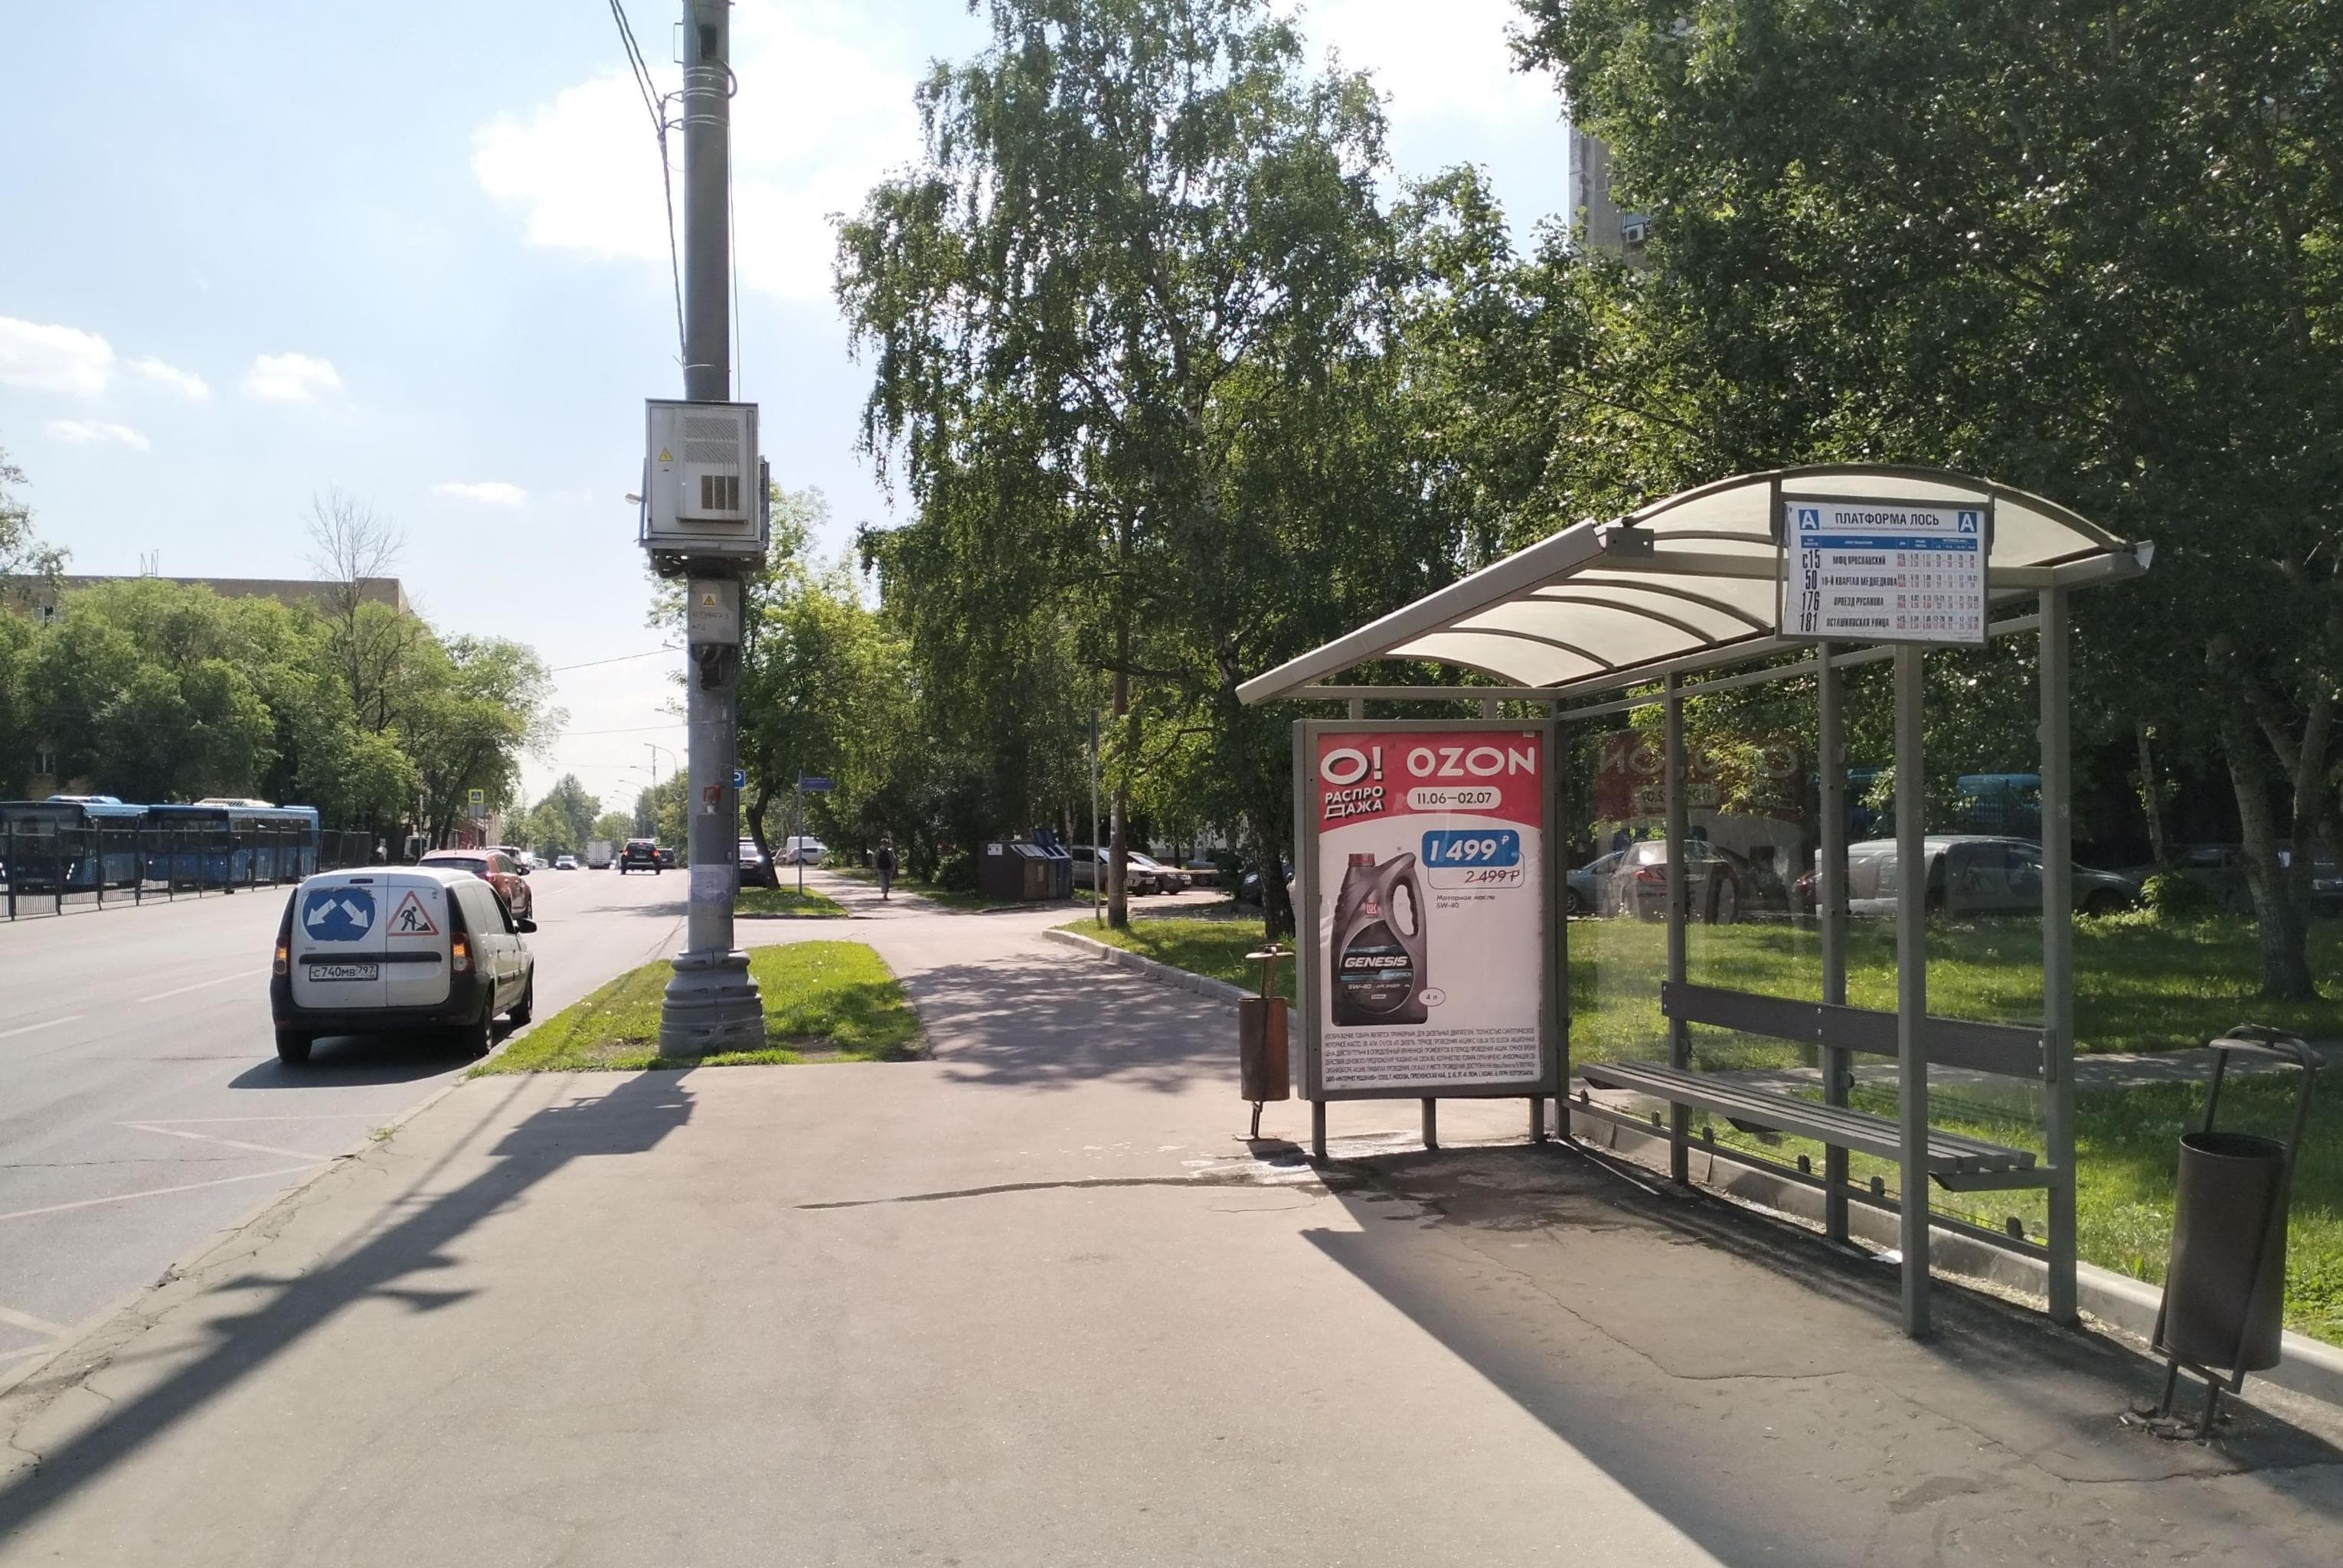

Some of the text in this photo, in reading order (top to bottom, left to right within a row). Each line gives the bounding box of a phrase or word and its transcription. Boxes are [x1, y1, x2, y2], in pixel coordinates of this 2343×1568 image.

[1801, 511, 1817, 529] А
[1835, 512, 1939, 526] ПЛАТФОРМА ЛОСЬ
[1959, 513, 1975, 532] А
[1848, 555, 1886, 565] ЯРОСЛАВСКИЙ
[1805, 570, 1818, 590] 50
[1835, 577, 1859, 586] КВАРТАЛ
[1860, 577, 1897, 586] МЕДВЕДКОВА
[1802, 591, 1820, 611] 176
[1833, 596, 1884, 606] ПРОЕЗД РУСАНОВА
[1800, 612, 1818, 632] 181
[1826, 617, 1870, 627] ОСТАШКОВСКАЯ
[1871, 618, 1889, 628] УЛИЦА
[1407, 746, 1535, 777] OZON
[1325, 786, 1384, 804] РАСПРО
[1324, 801, 1384, 819] ДАЖА
[1345, 956, 1408, 969] GENESIS
